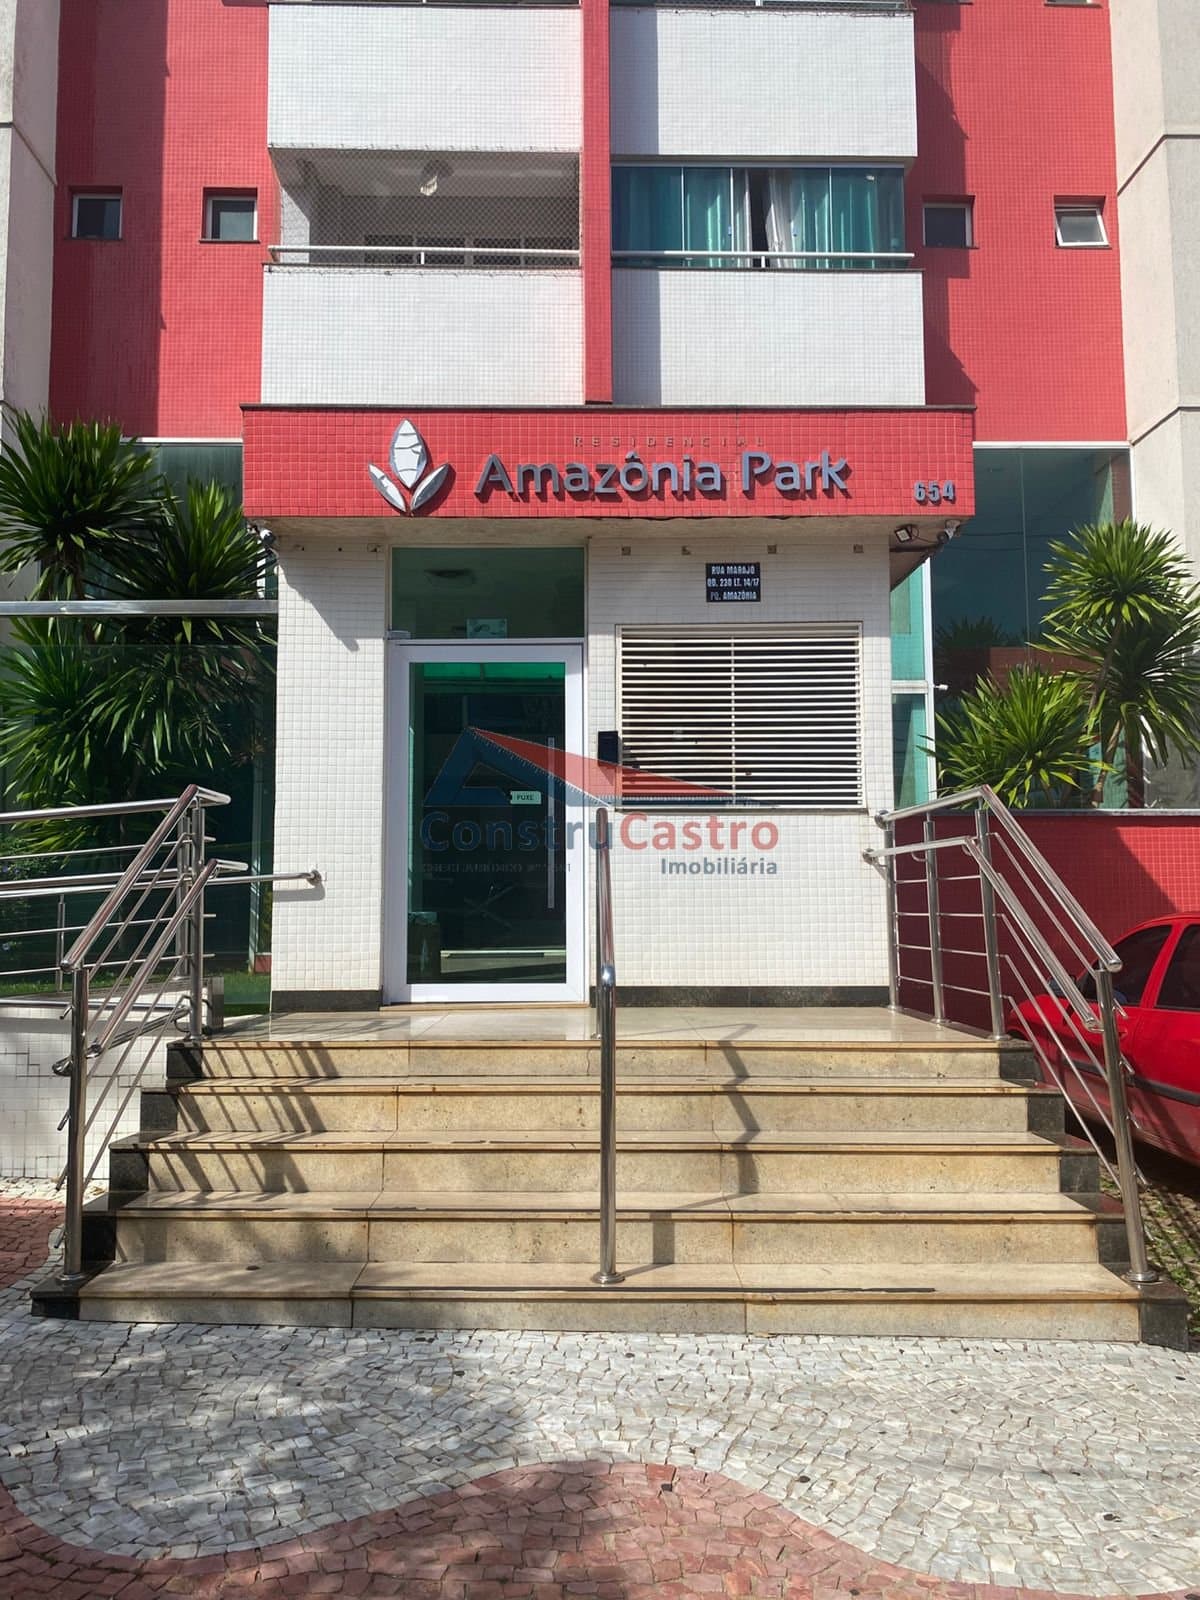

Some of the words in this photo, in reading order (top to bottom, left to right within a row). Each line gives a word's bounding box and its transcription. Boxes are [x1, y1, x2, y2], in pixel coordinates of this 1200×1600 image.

[574, 436, 765, 448] RESIDENCIAL
[474, 451, 721, 495] Amazônia
[742, 450, 846, 493] Park
[913, 480, 955, 502] 654
[711, 565, 725, 575] RUA
[723, 590, 757, 600] AMAZÔNIA
